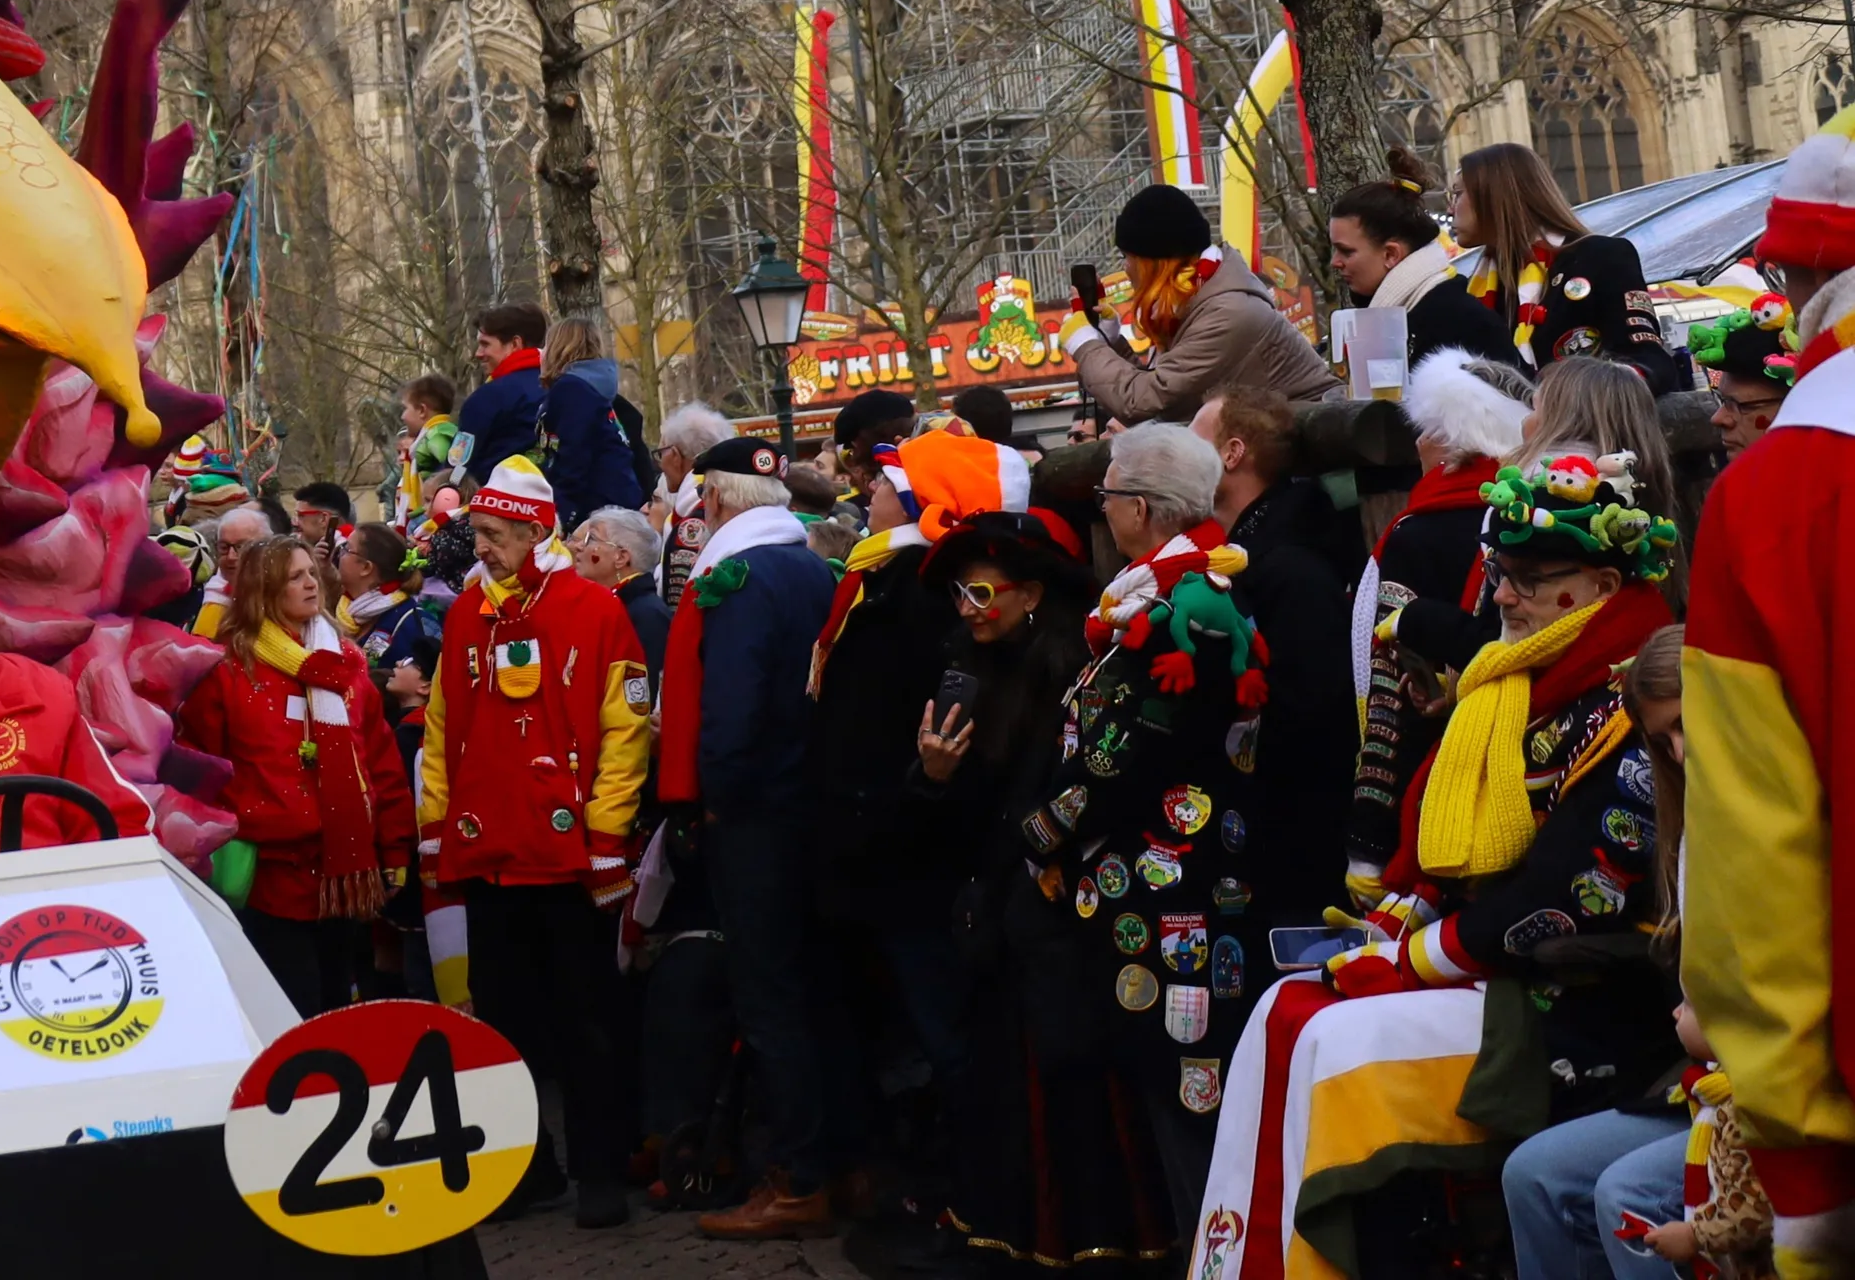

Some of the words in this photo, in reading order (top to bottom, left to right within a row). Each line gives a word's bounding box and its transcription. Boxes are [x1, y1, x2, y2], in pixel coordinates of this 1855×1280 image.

[758, 456, 771, 467] 50
[1091, 750, 1113, 770] 88
[1622, 761, 1655, 805] ZANDHAZ
[37, 911, 66, 928] OP
[83, 913, 127, 940] TIJD
[129, 942, 158, 996] THUIS
[28, 1016, 150, 1056] OETELDONK
[265, 1029, 486, 1217] 24
